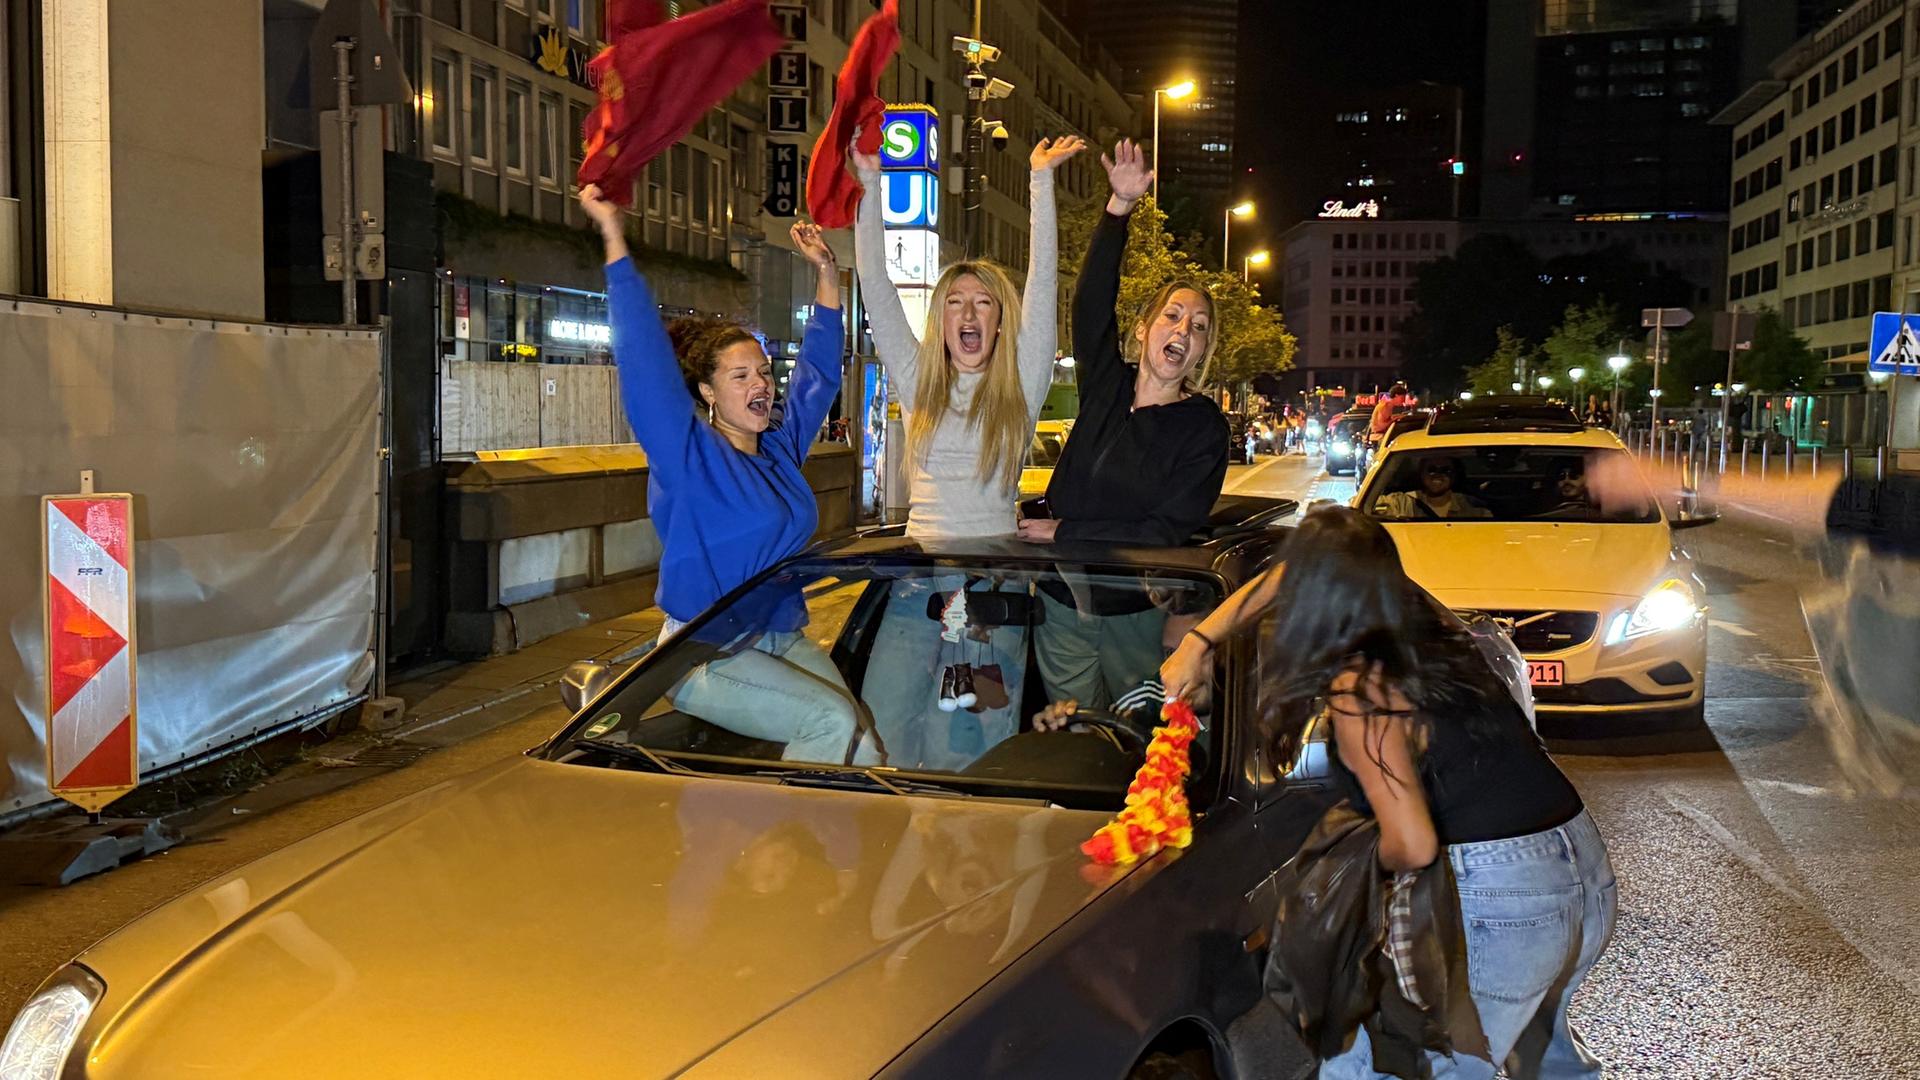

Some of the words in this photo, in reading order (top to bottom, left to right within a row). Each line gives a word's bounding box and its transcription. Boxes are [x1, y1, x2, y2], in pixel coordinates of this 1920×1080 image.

[886, 122, 914, 159] S
[929, 125, 938, 162] S
[777, 147, 792, 213] KINO
[880, 174, 923, 224] U
[926, 175, 939, 226] U
[1318, 200, 1367, 218] Lindt
